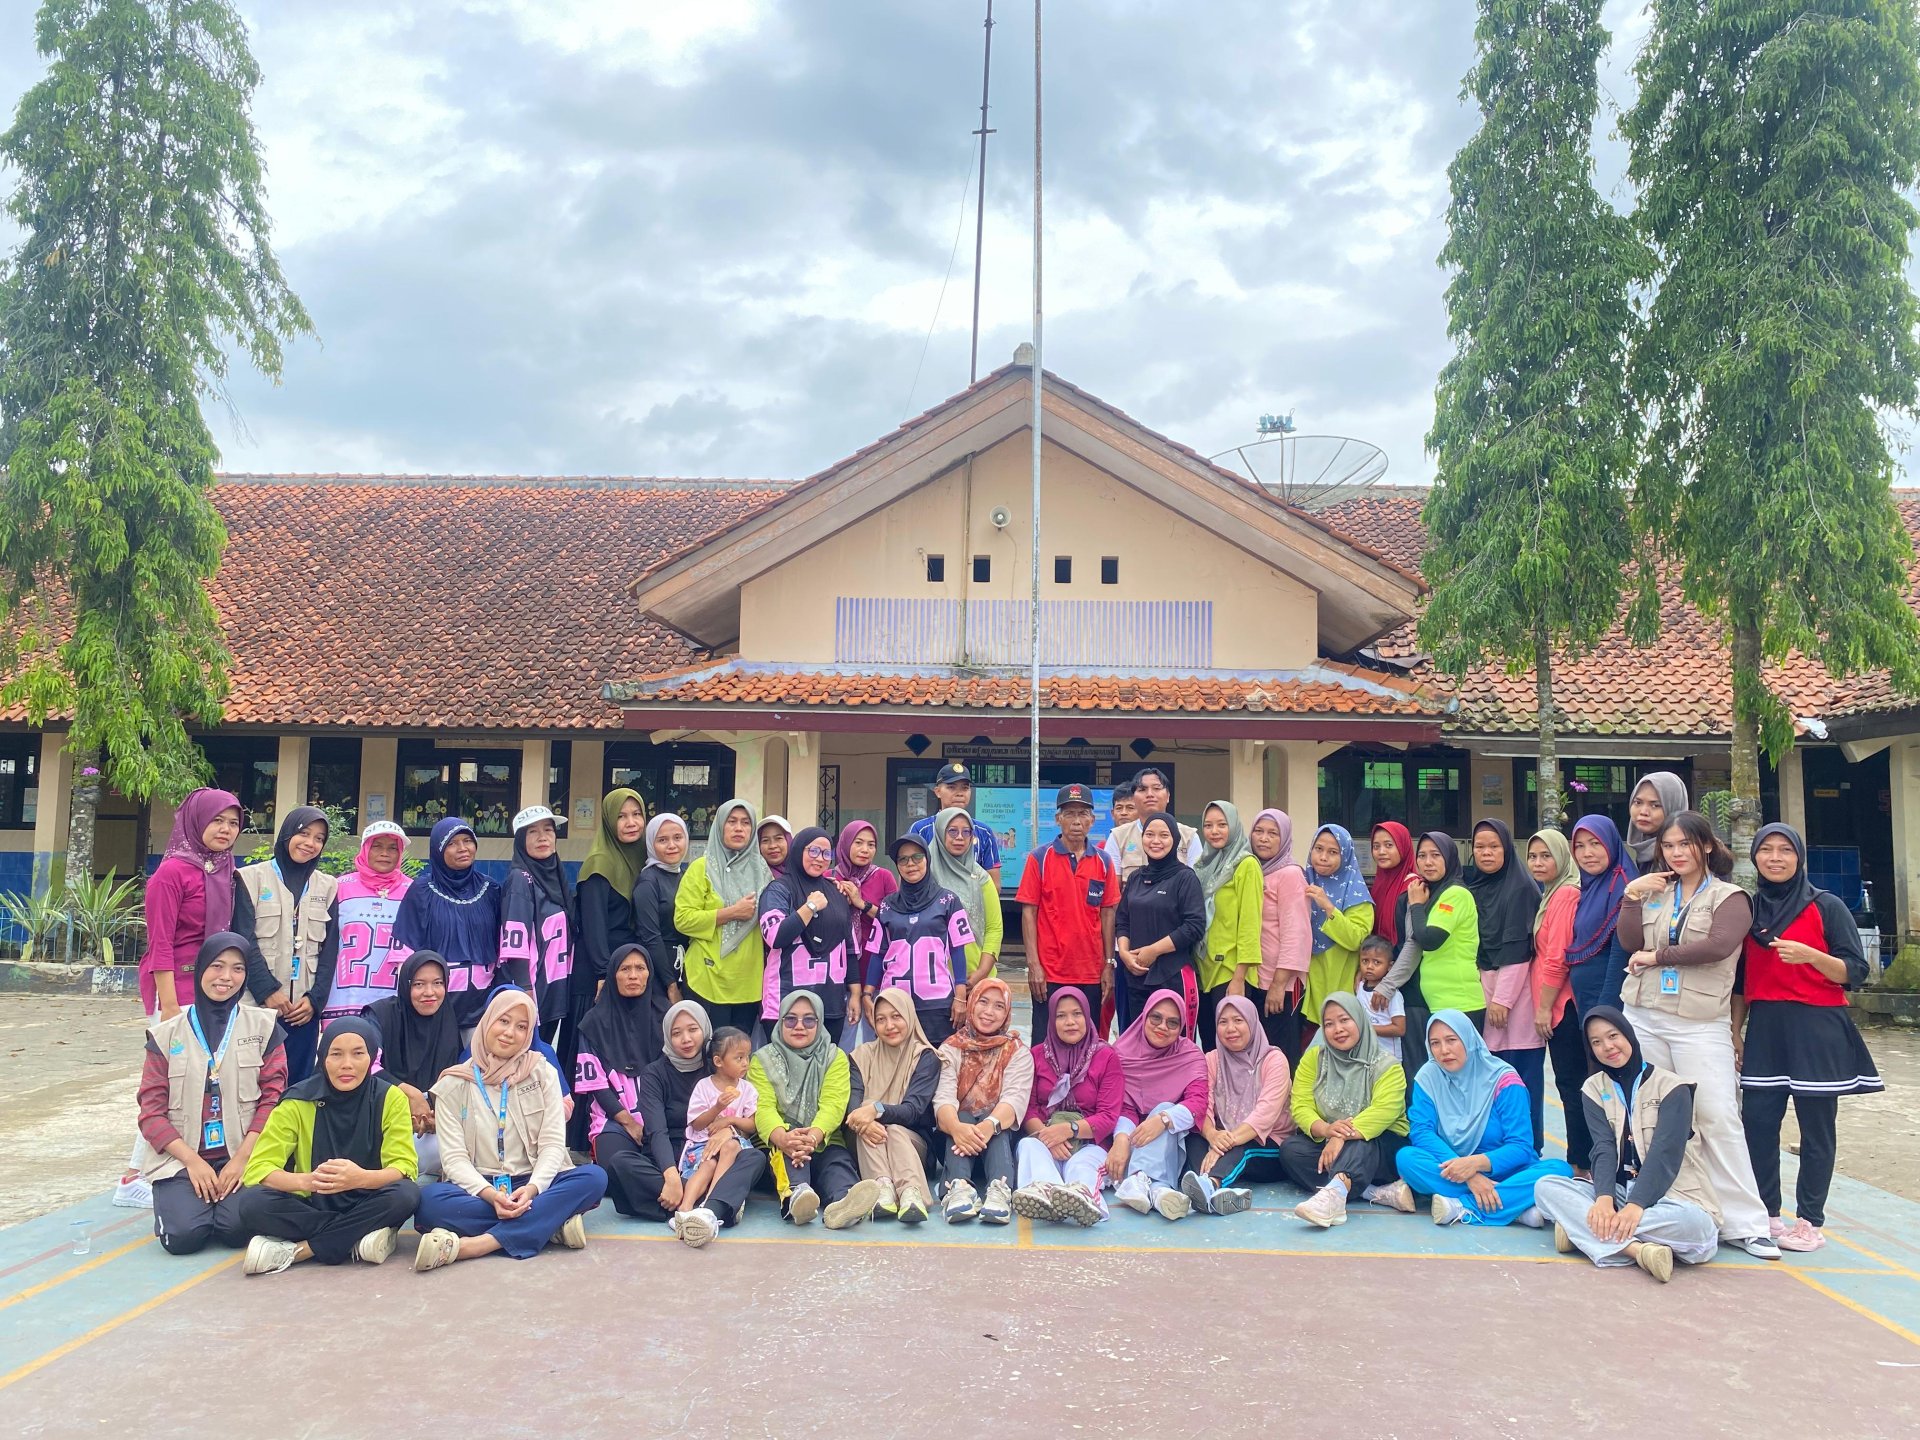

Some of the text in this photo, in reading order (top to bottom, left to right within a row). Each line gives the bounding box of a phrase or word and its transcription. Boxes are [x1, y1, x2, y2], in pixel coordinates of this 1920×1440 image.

[337, 921, 400, 989] 27
[502, 930, 523, 948] 20
[881, 936, 953, 1000] 20
